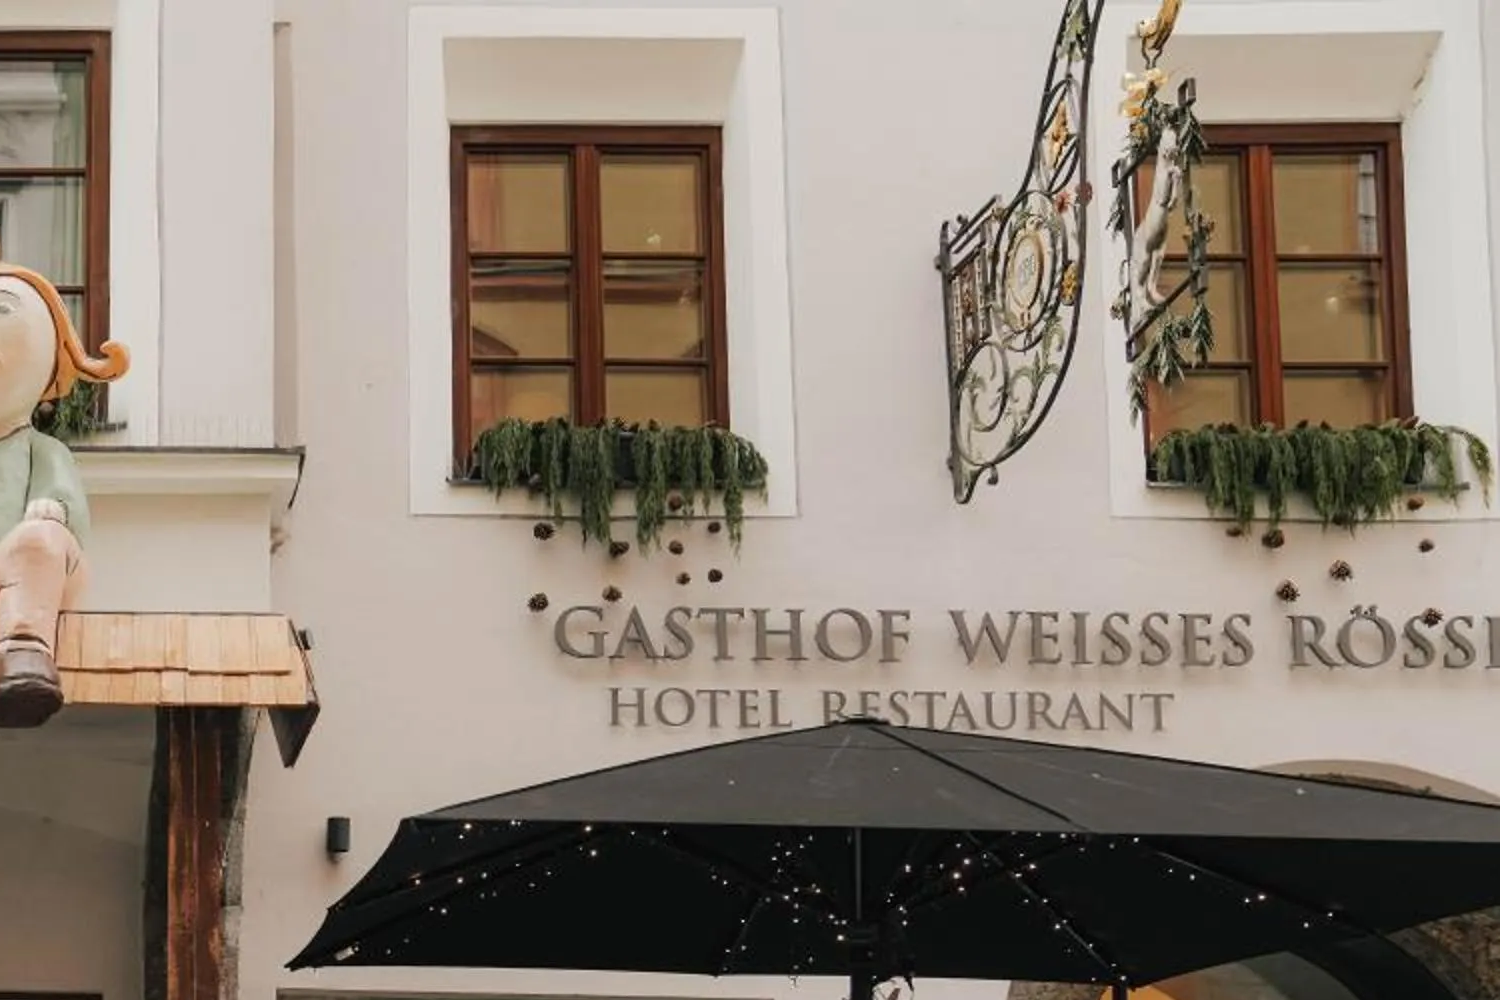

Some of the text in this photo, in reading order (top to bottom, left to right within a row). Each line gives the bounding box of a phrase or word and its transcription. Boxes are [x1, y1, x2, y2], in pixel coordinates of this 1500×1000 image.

[553, 605, 911, 664] GASTHOF
[947, 609, 1255, 670] WEISSES
[608, 687, 1174, 732] HOTEL RESTAURANT
